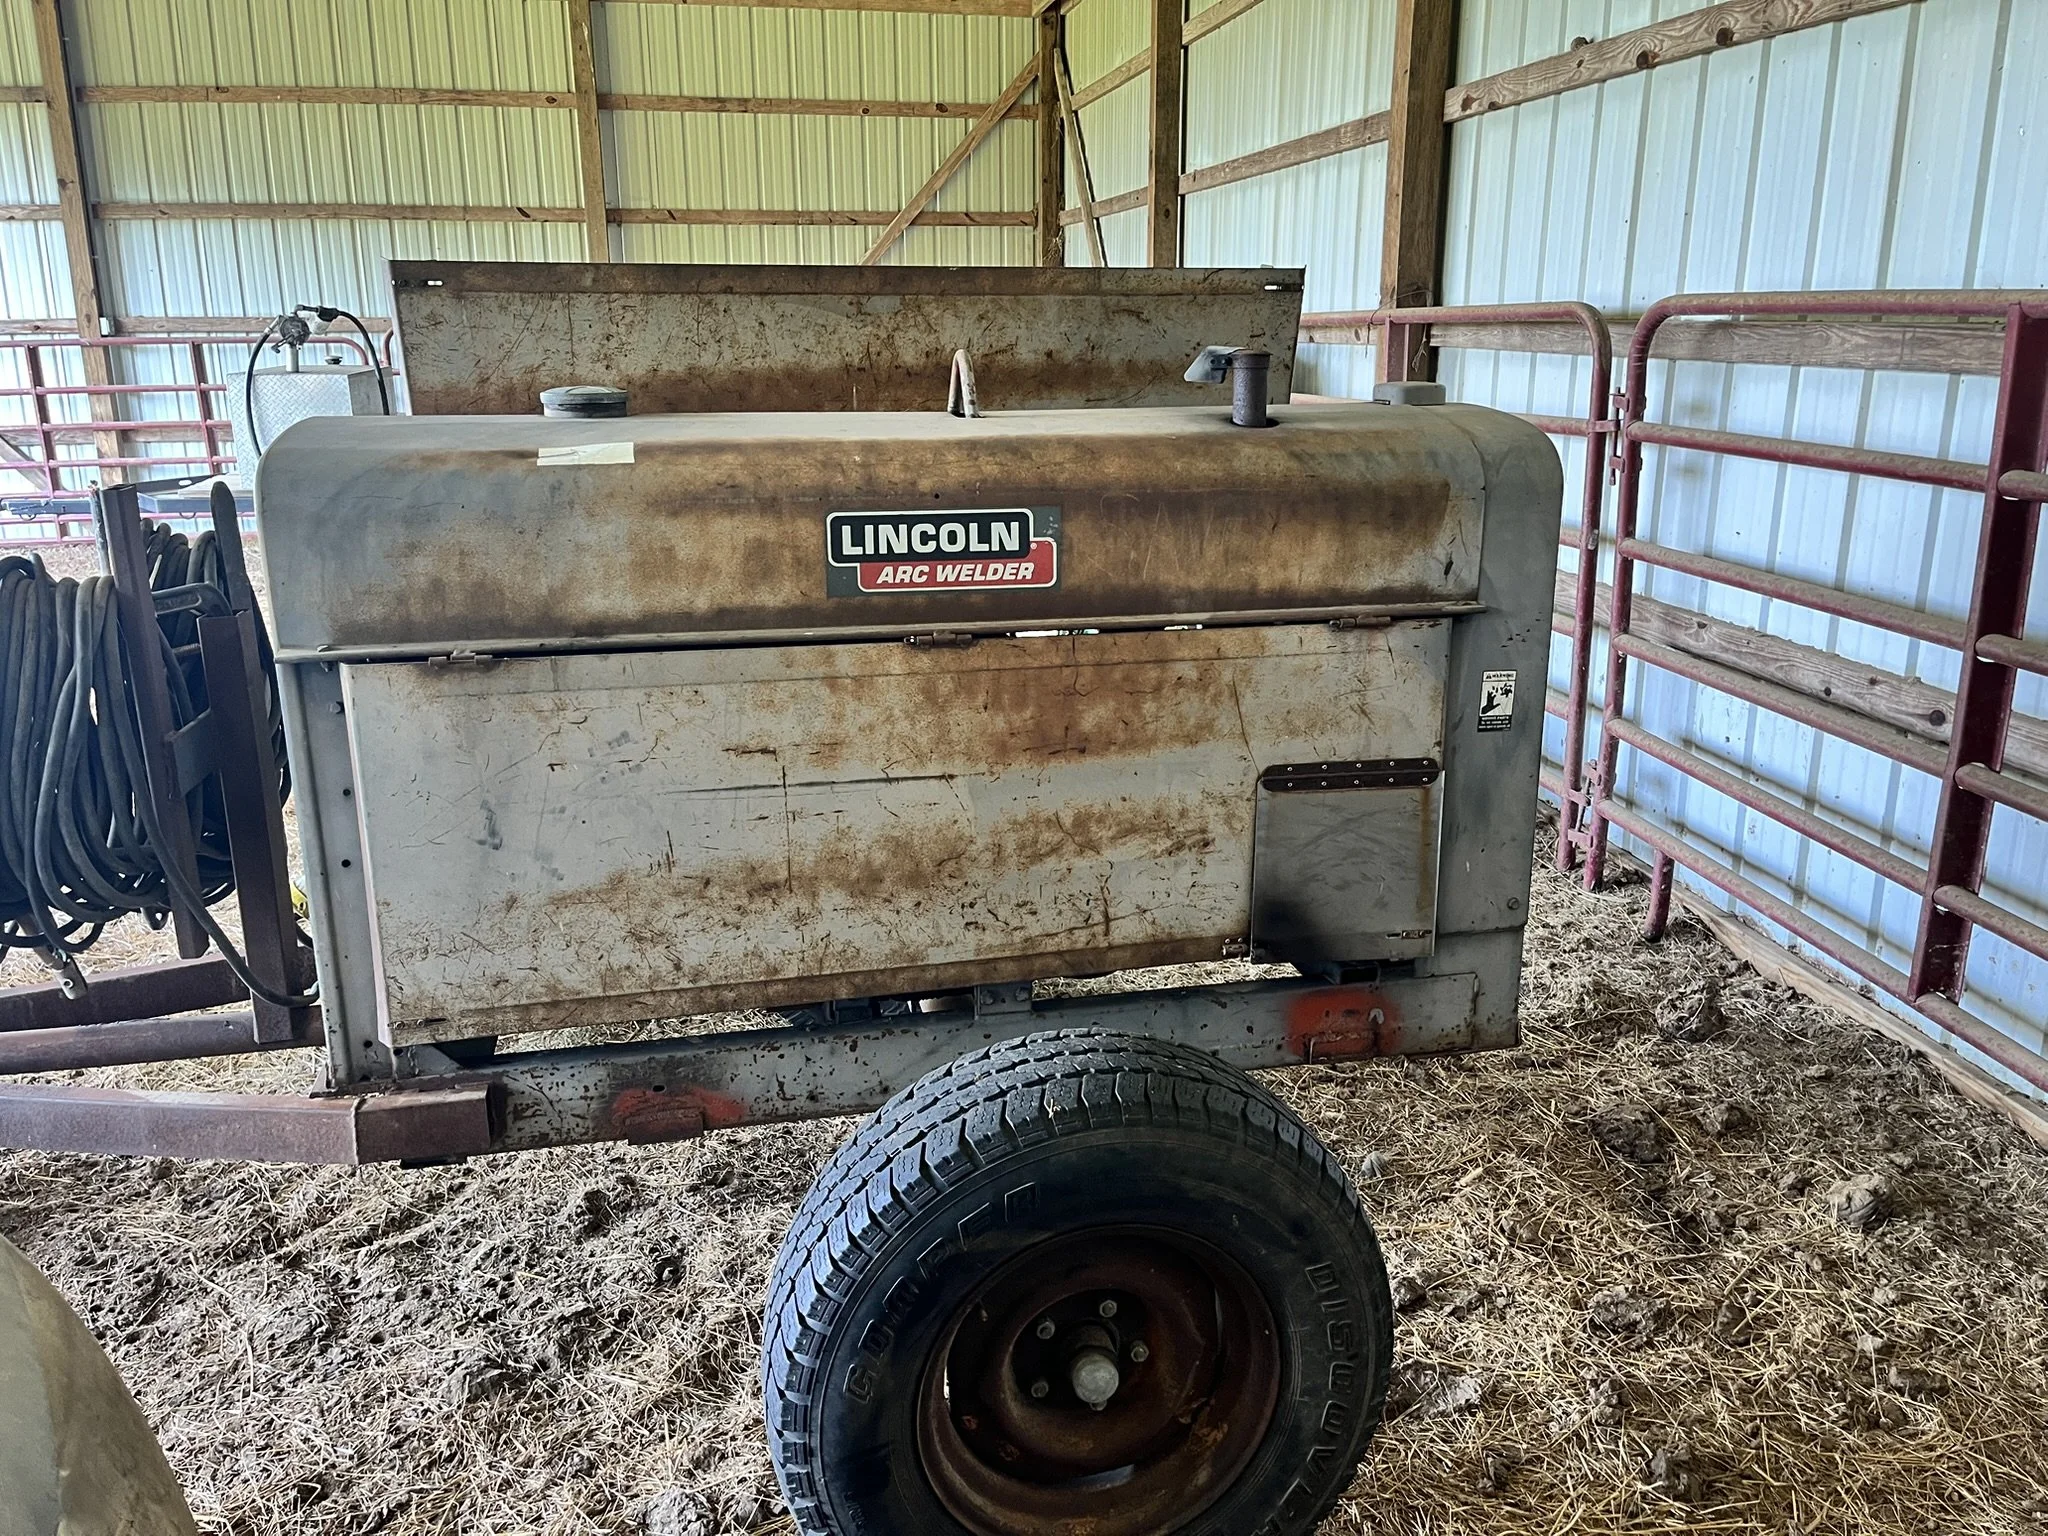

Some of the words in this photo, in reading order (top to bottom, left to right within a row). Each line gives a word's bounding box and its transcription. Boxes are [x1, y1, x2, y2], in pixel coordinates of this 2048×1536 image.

[841, 521, 1020, 556] LINCOLN
[876, 564, 930, 584] ARC
[936, 562, 1035, 583] WELDER
